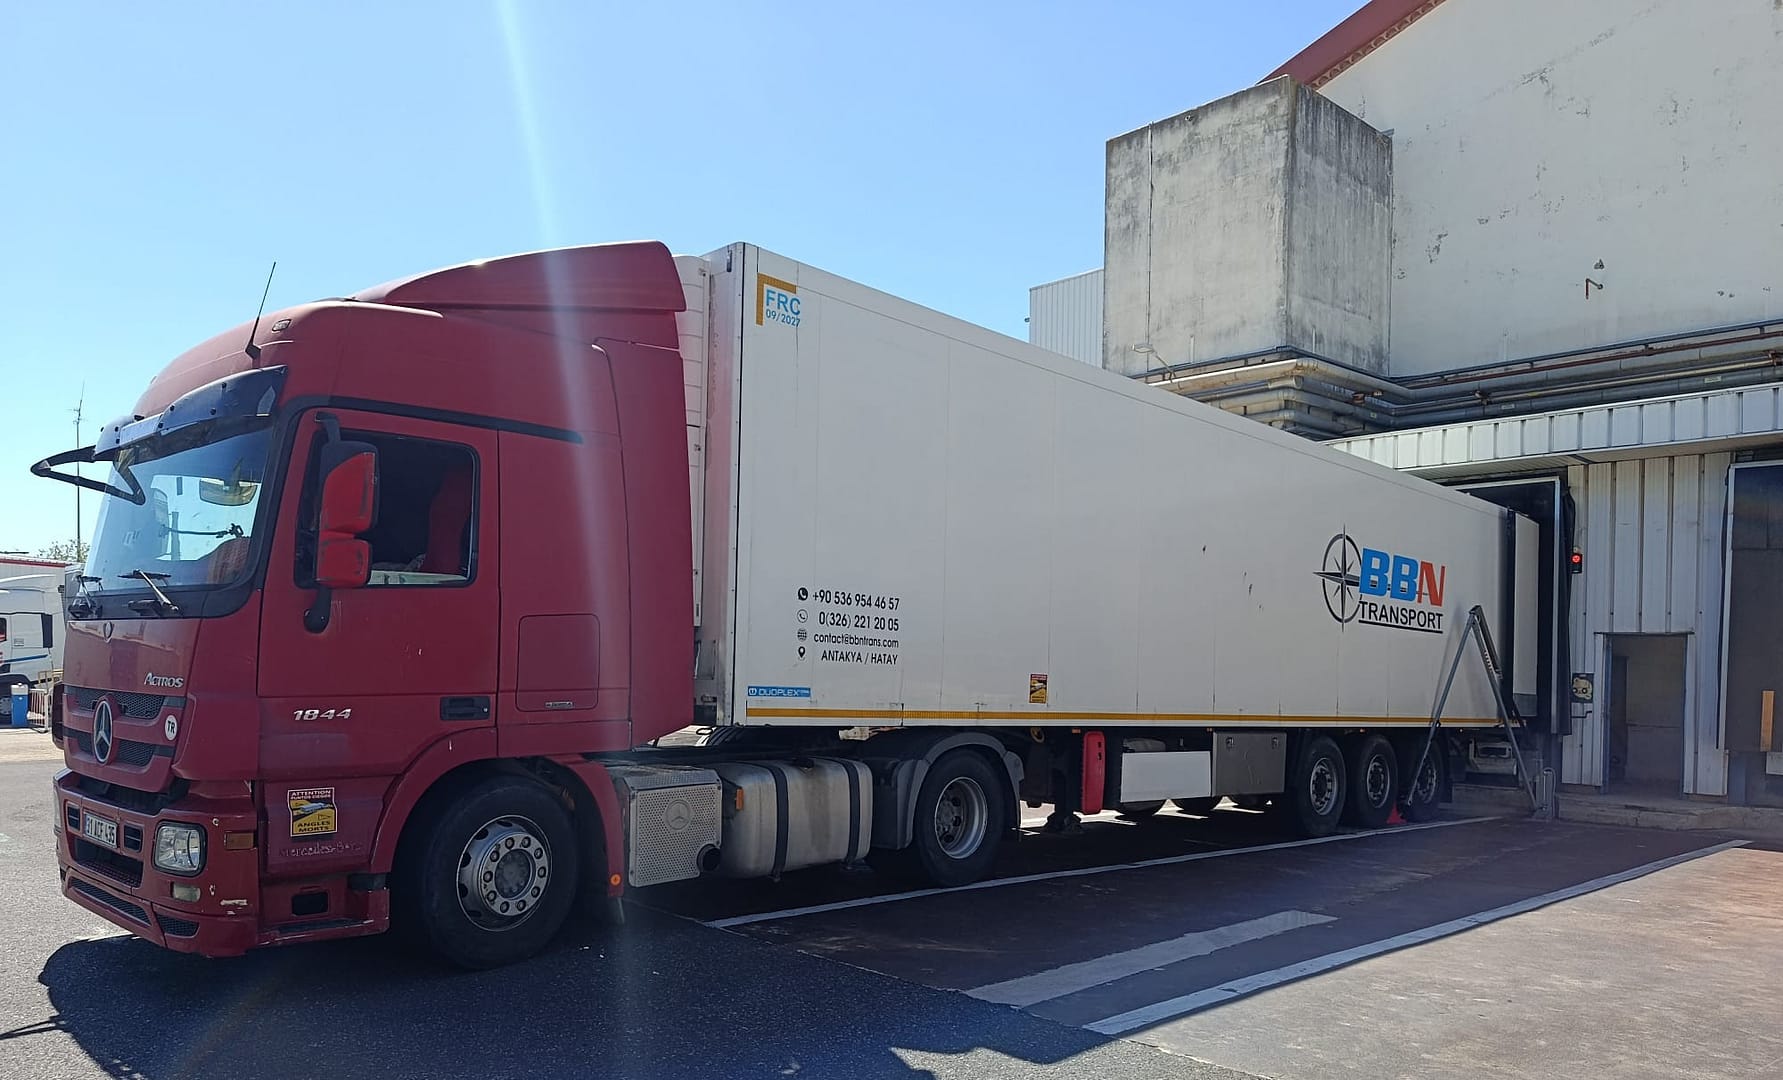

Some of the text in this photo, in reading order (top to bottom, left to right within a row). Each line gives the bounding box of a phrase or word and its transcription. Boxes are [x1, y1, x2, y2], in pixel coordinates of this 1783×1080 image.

[766, 288, 801, 316] FRC
[766, 309, 801, 327] 09/2027
[1359, 547, 1446, 607] BBN
[813, 589, 900, 611] +90 536 954 46 57
[819, 611, 899, 631] 0(326) 221 20 05
[1359, 600, 1443, 630] TRANSPORT
[814, 633, 899, 648] contact@bbntrans.com
[821, 650, 862, 663] ANTAKYA
[871, 653, 898, 665] HATAY
[293, 708, 352, 720] 1844
[167, 720, 176, 734] TR
